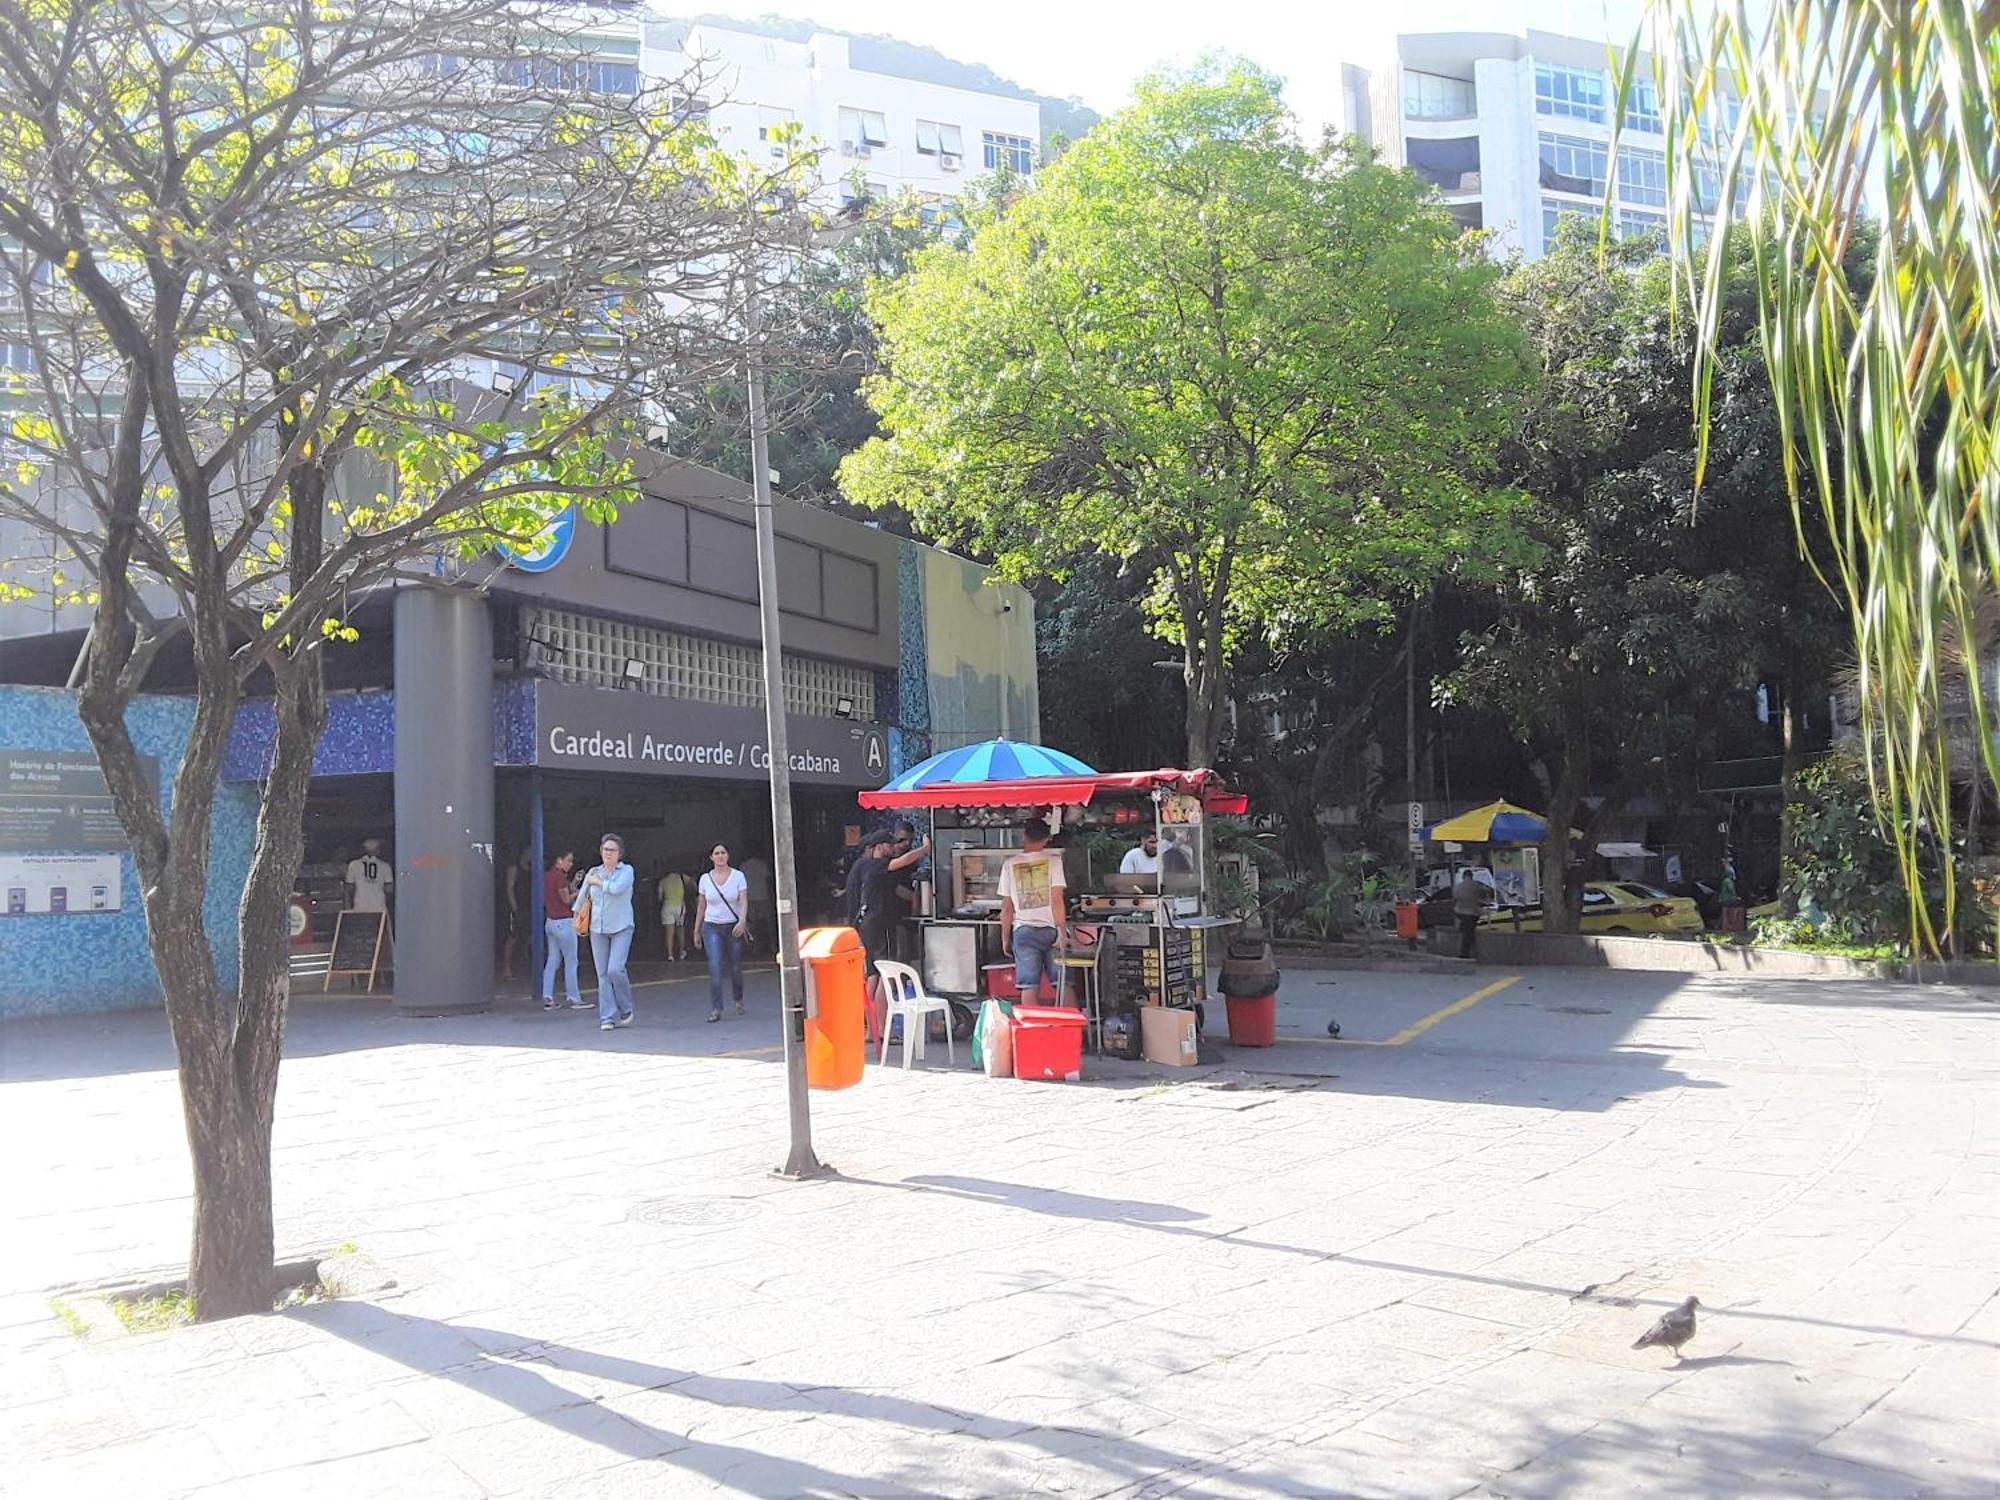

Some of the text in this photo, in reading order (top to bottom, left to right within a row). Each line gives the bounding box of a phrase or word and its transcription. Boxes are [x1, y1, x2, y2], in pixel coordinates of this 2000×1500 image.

[550, 726, 841, 773] Cardeal Arcoverde / Cocabana
[867, 737, 882, 767] A
[362, 861, 378, 880] 10
